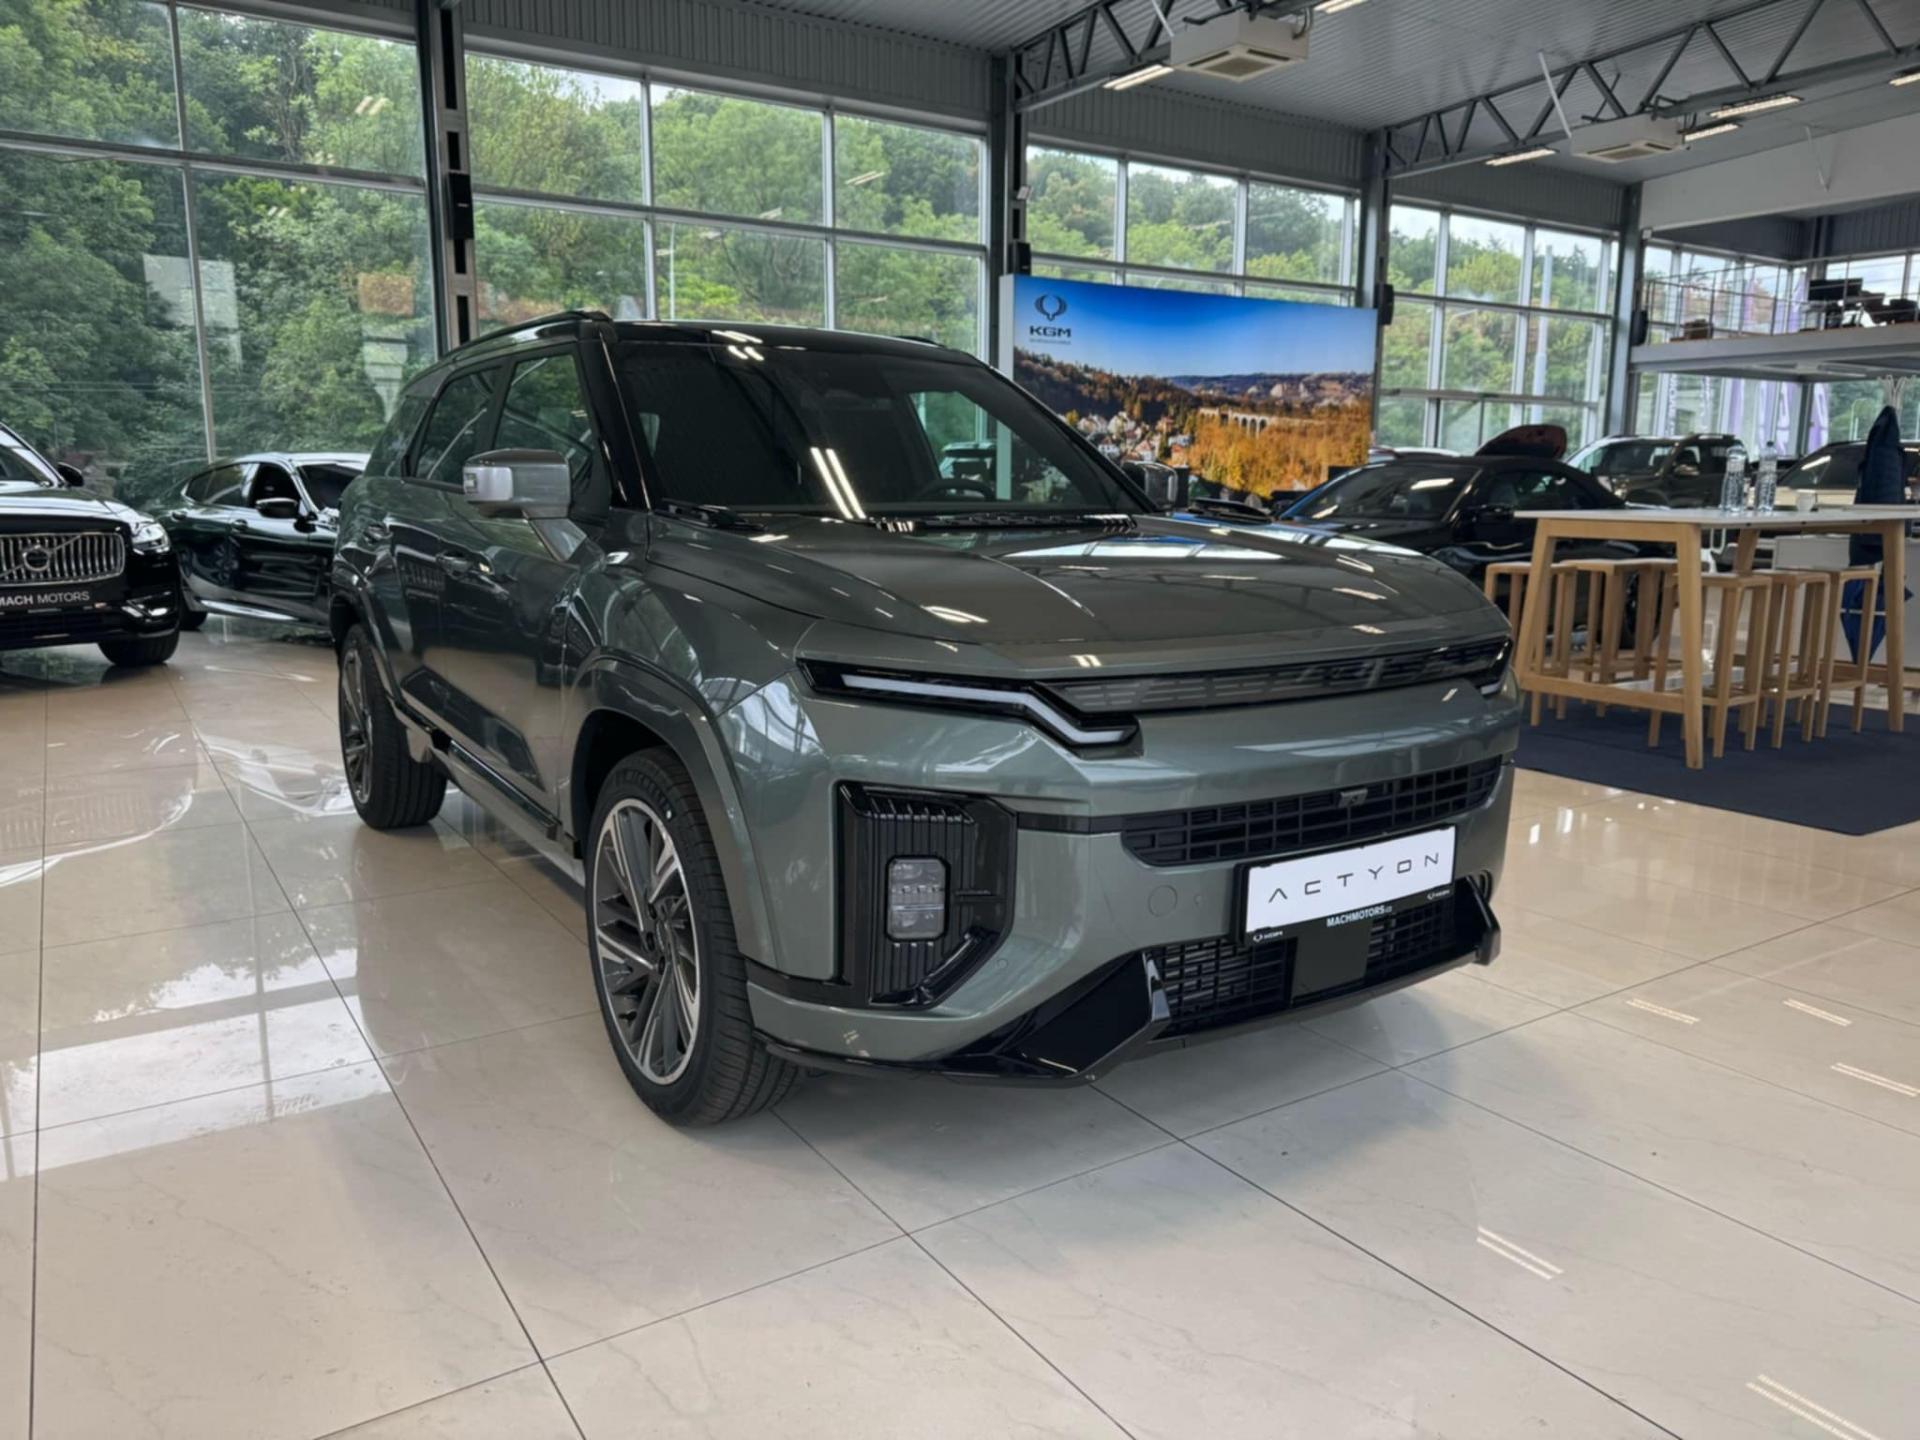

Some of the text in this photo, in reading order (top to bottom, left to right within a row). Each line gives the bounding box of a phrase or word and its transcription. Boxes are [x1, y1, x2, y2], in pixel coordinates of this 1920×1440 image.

[1029, 325, 1071, 338] KGM
[37, 591, 90, 604] MOTORS
[1269, 853, 1439, 903] ACTYON
